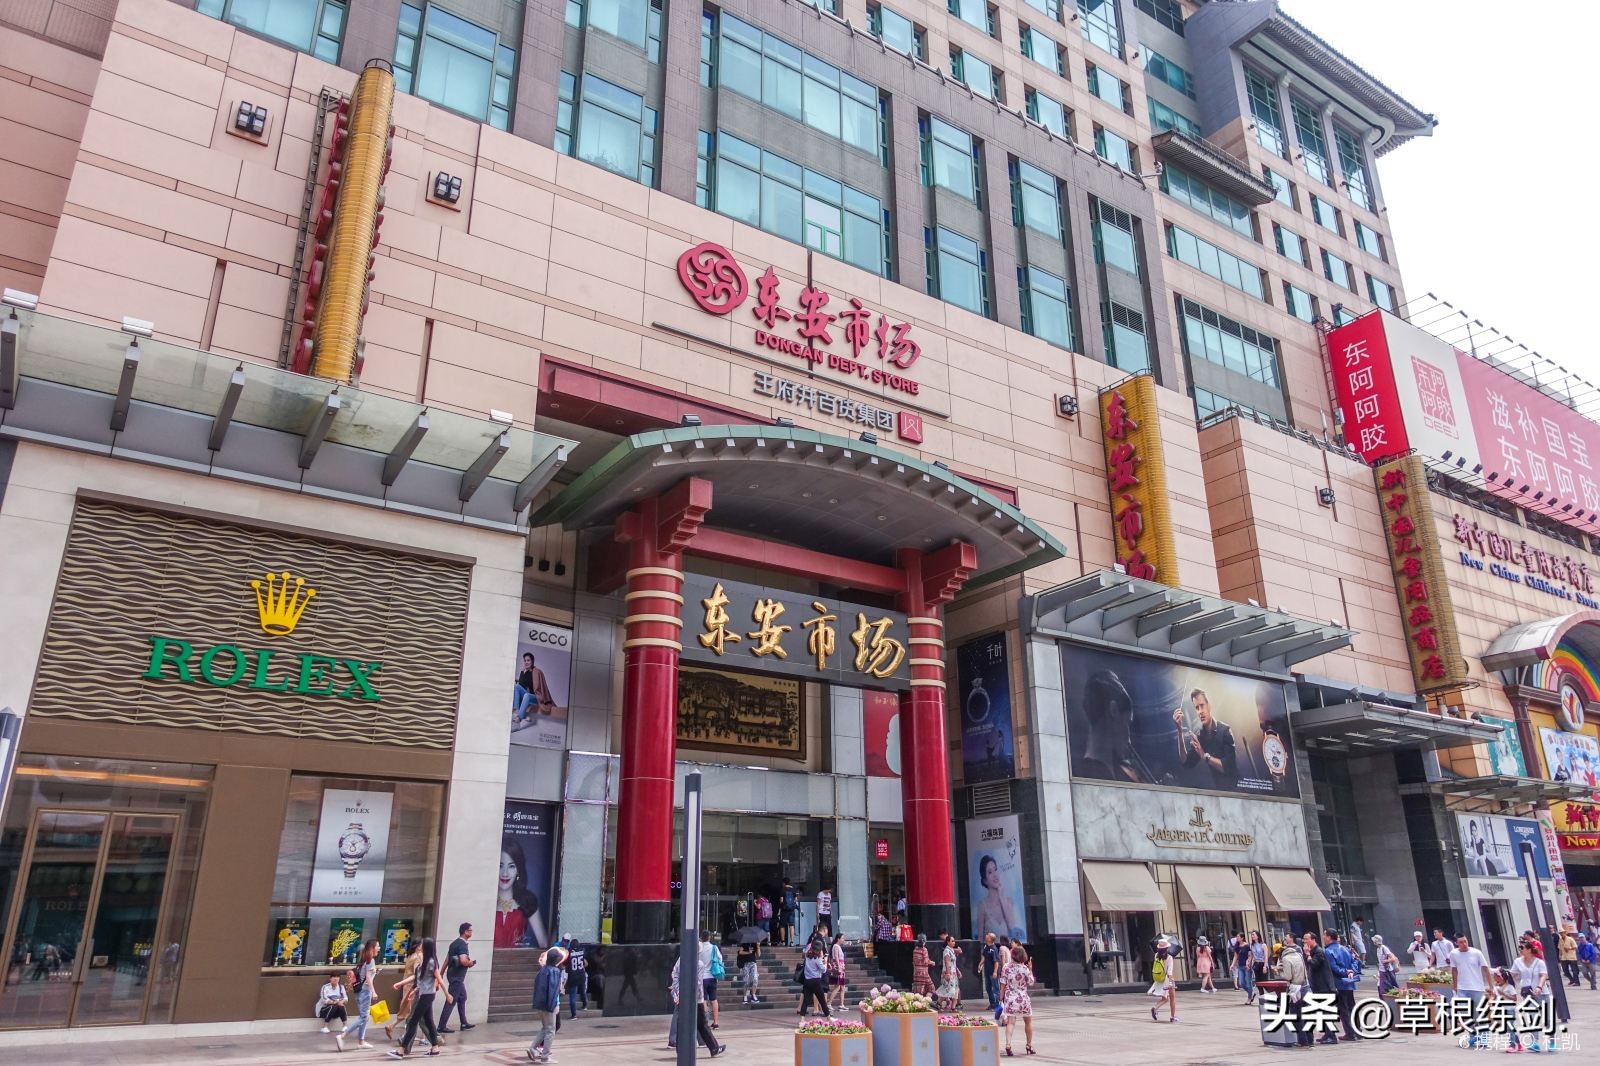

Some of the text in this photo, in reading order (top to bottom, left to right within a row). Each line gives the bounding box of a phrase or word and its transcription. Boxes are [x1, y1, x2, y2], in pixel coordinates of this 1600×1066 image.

[753, 266, 922, 369] 东安市场
[756, 330, 919, 395] DONGAN DEPT. STORE
[1342, 339, 1388, 453] 东阿阿胶
[754, 371, 894, 432] 王府井百货集团
[1485, 386, 1593, 470] 滋补国宝
[1107, 390, 1156, 581] 东安市场
[1497, 436, 1600, 512] 东阿阿胶
[1380, 468, 1447, 682] 新中国儿童用品商店
[1453, 513, 1594, 594] 新中国儿童用品商店
[1459, 551, 1599, 609] New China Children's Store
[140, 635, 383, 701] ROLEX
[528, 629, 568, 647] ecco
[699, 582, 906, 678] 东安市场
[1567, 835, 1598, 847] New
[571, 956, 584, 971] 85
